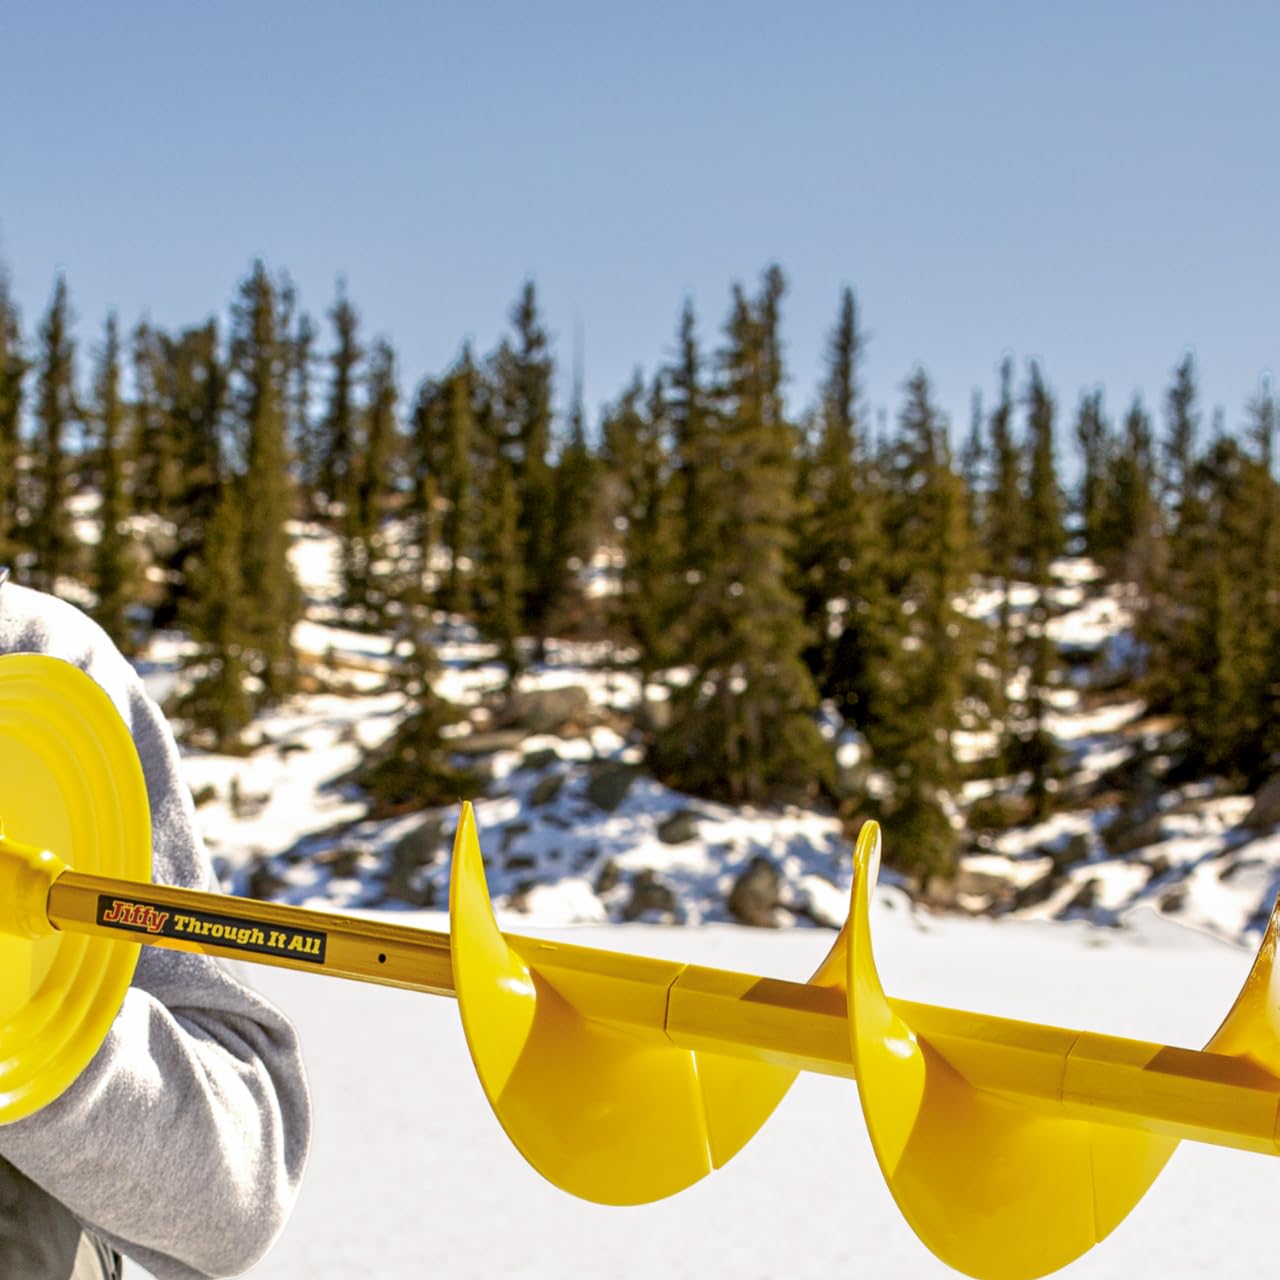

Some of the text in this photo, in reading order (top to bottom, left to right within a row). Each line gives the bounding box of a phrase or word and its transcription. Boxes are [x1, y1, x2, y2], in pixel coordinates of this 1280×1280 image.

[103, 900, 321, 955] Jiffy Through It All
